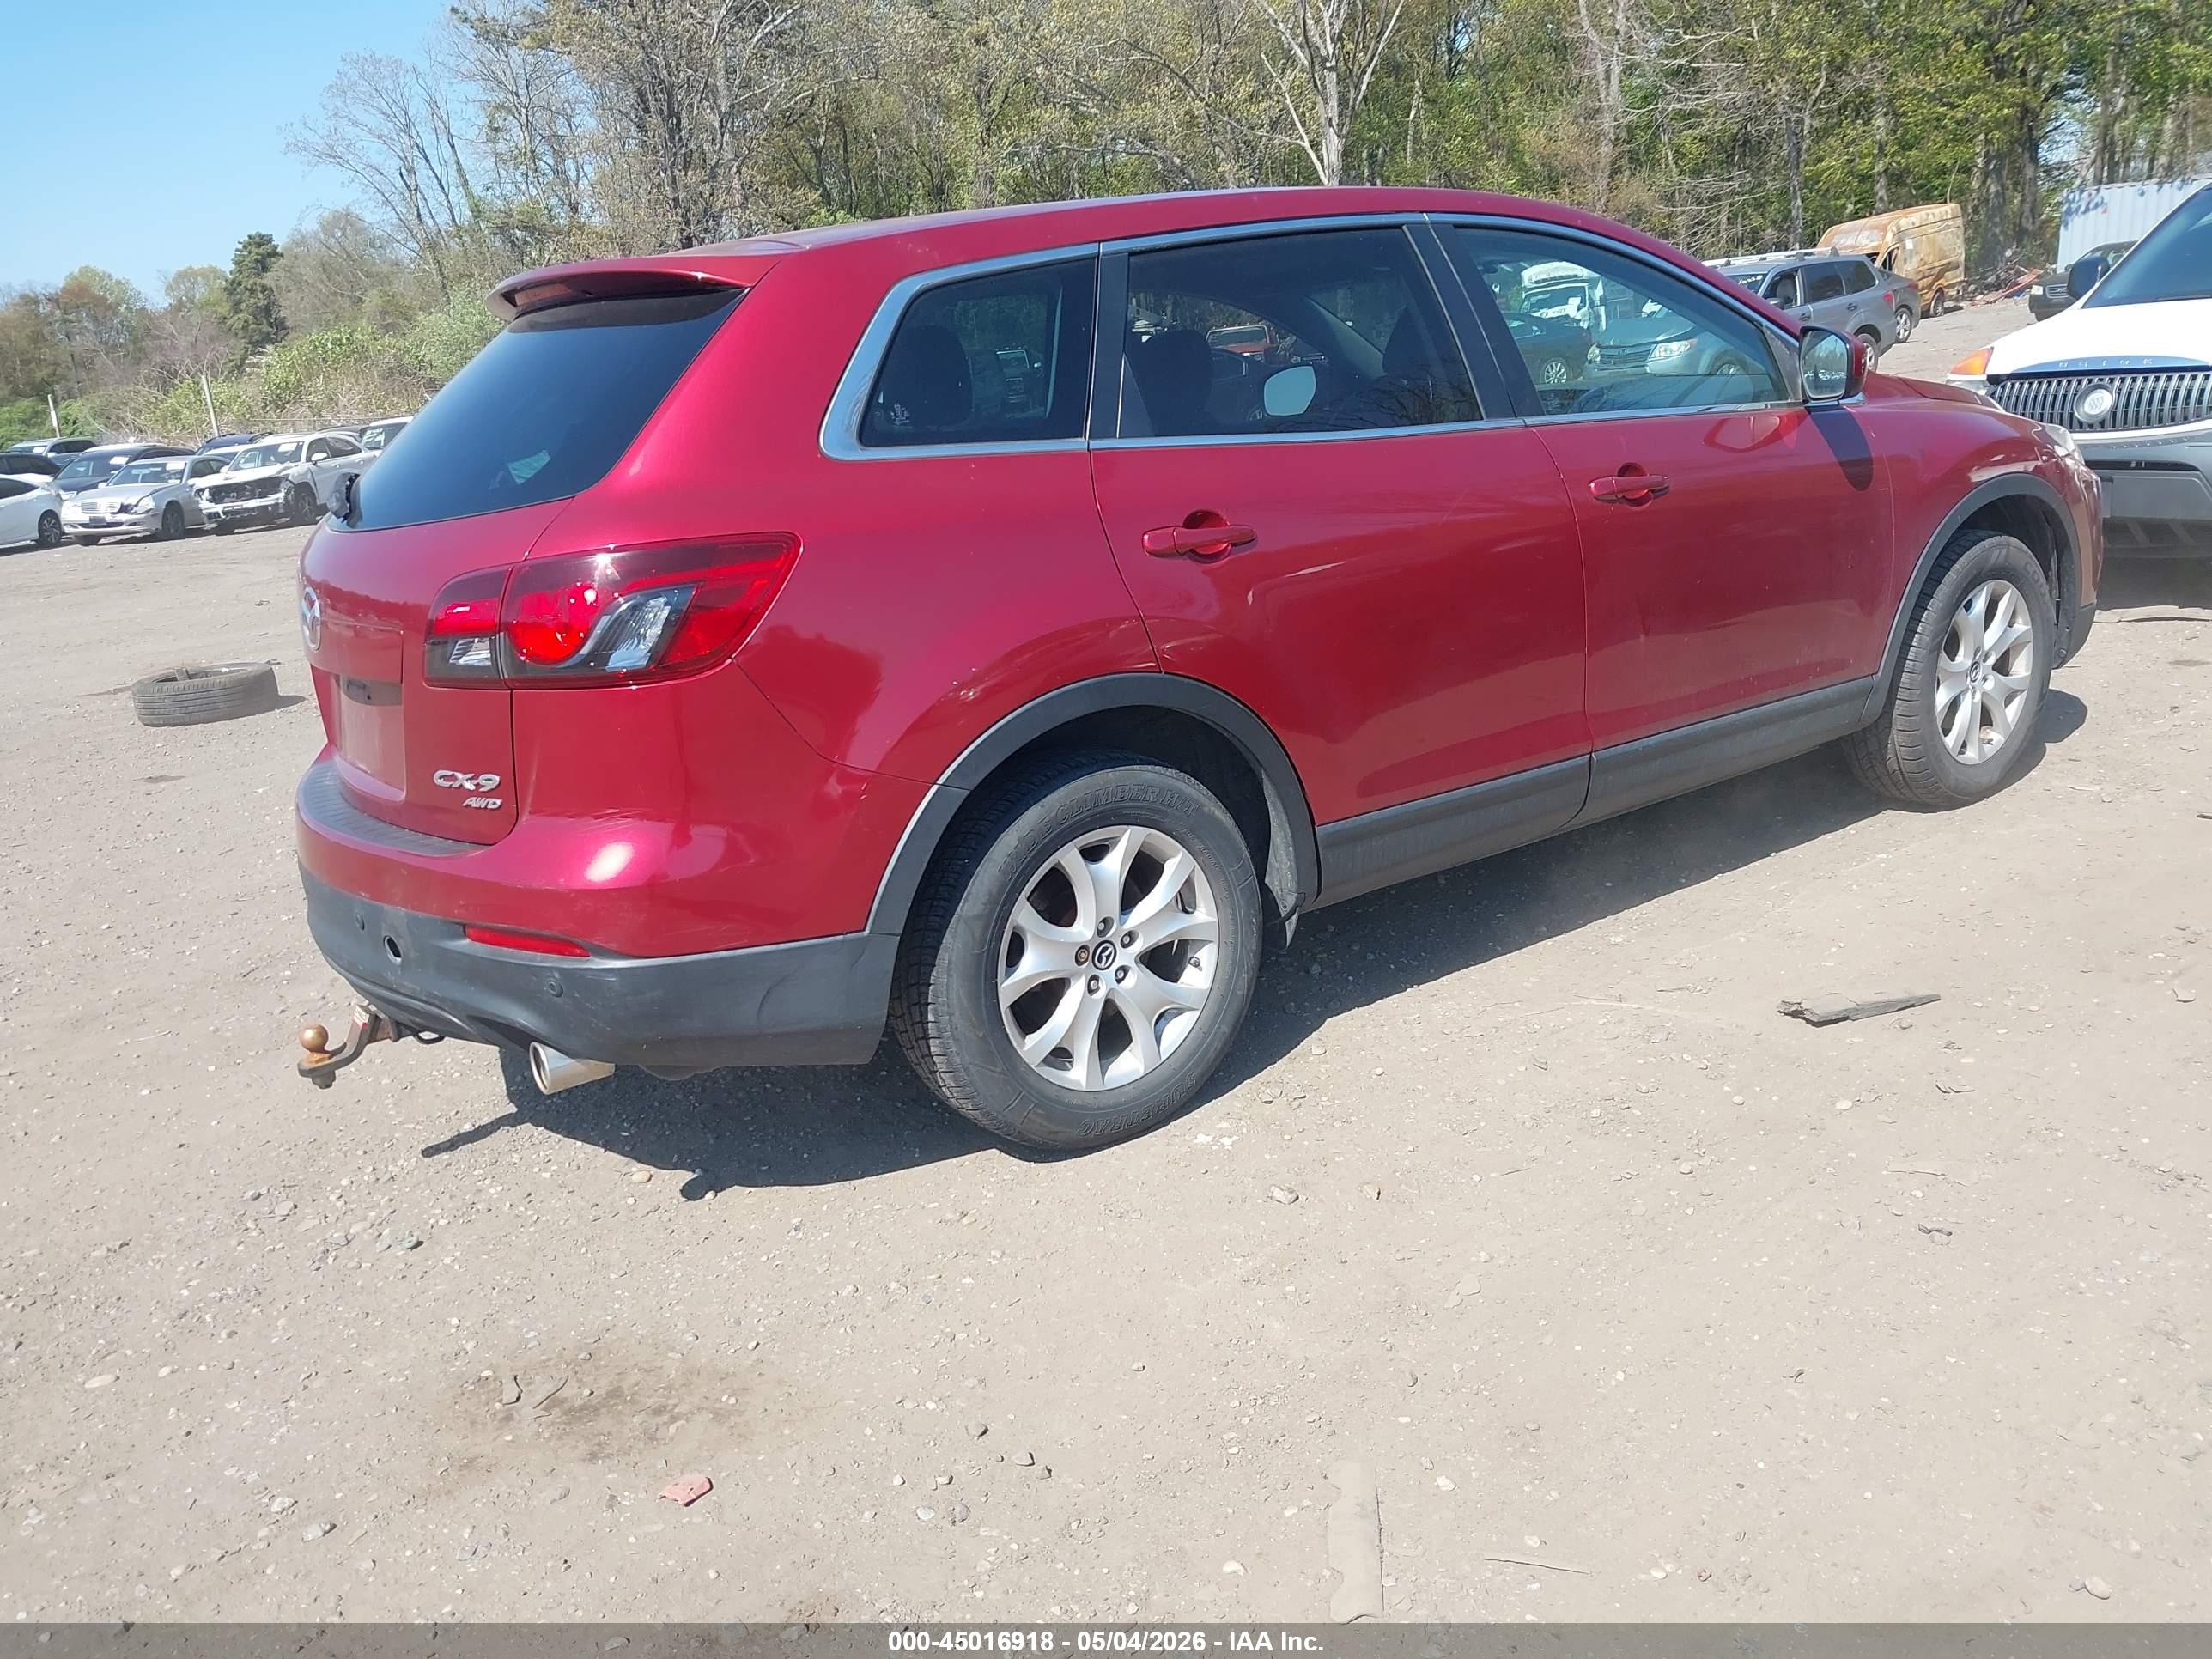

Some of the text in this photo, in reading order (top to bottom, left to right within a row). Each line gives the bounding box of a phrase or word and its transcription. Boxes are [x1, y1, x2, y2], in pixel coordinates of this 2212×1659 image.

[433, 769, 501, 792] CX-9
[463, 797, 502, 810] AWD
[1055, 783, 1159, 825] CLIMBER
[1076, 1071, 1197, 1137] SURETRAC
